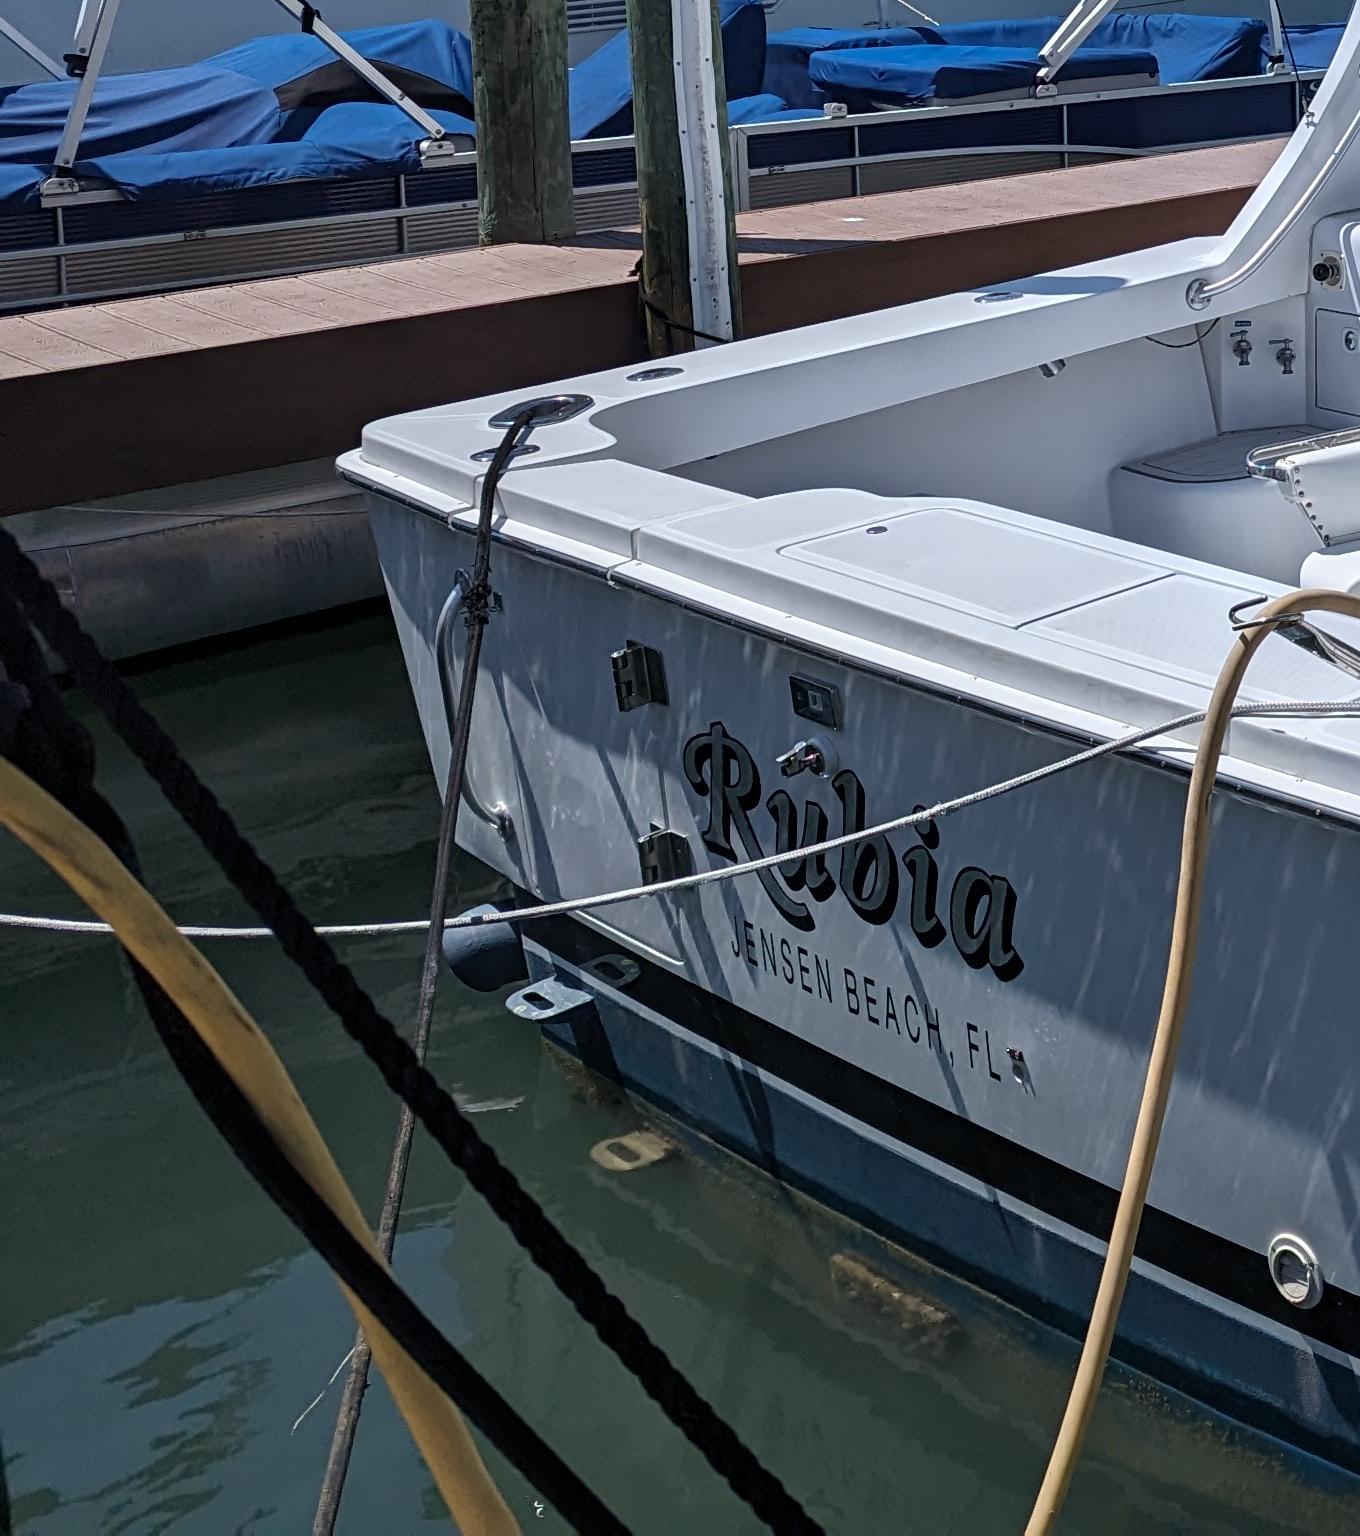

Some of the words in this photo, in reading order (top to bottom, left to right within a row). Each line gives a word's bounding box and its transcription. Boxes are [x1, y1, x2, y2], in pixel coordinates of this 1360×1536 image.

[682, 720, 1025, 983] Rubia
[730, 914, 833, 1004] JENSEN
[843, 967, 955, 1068] BEACH,
[967, 1022, 1001, 1082] FL
